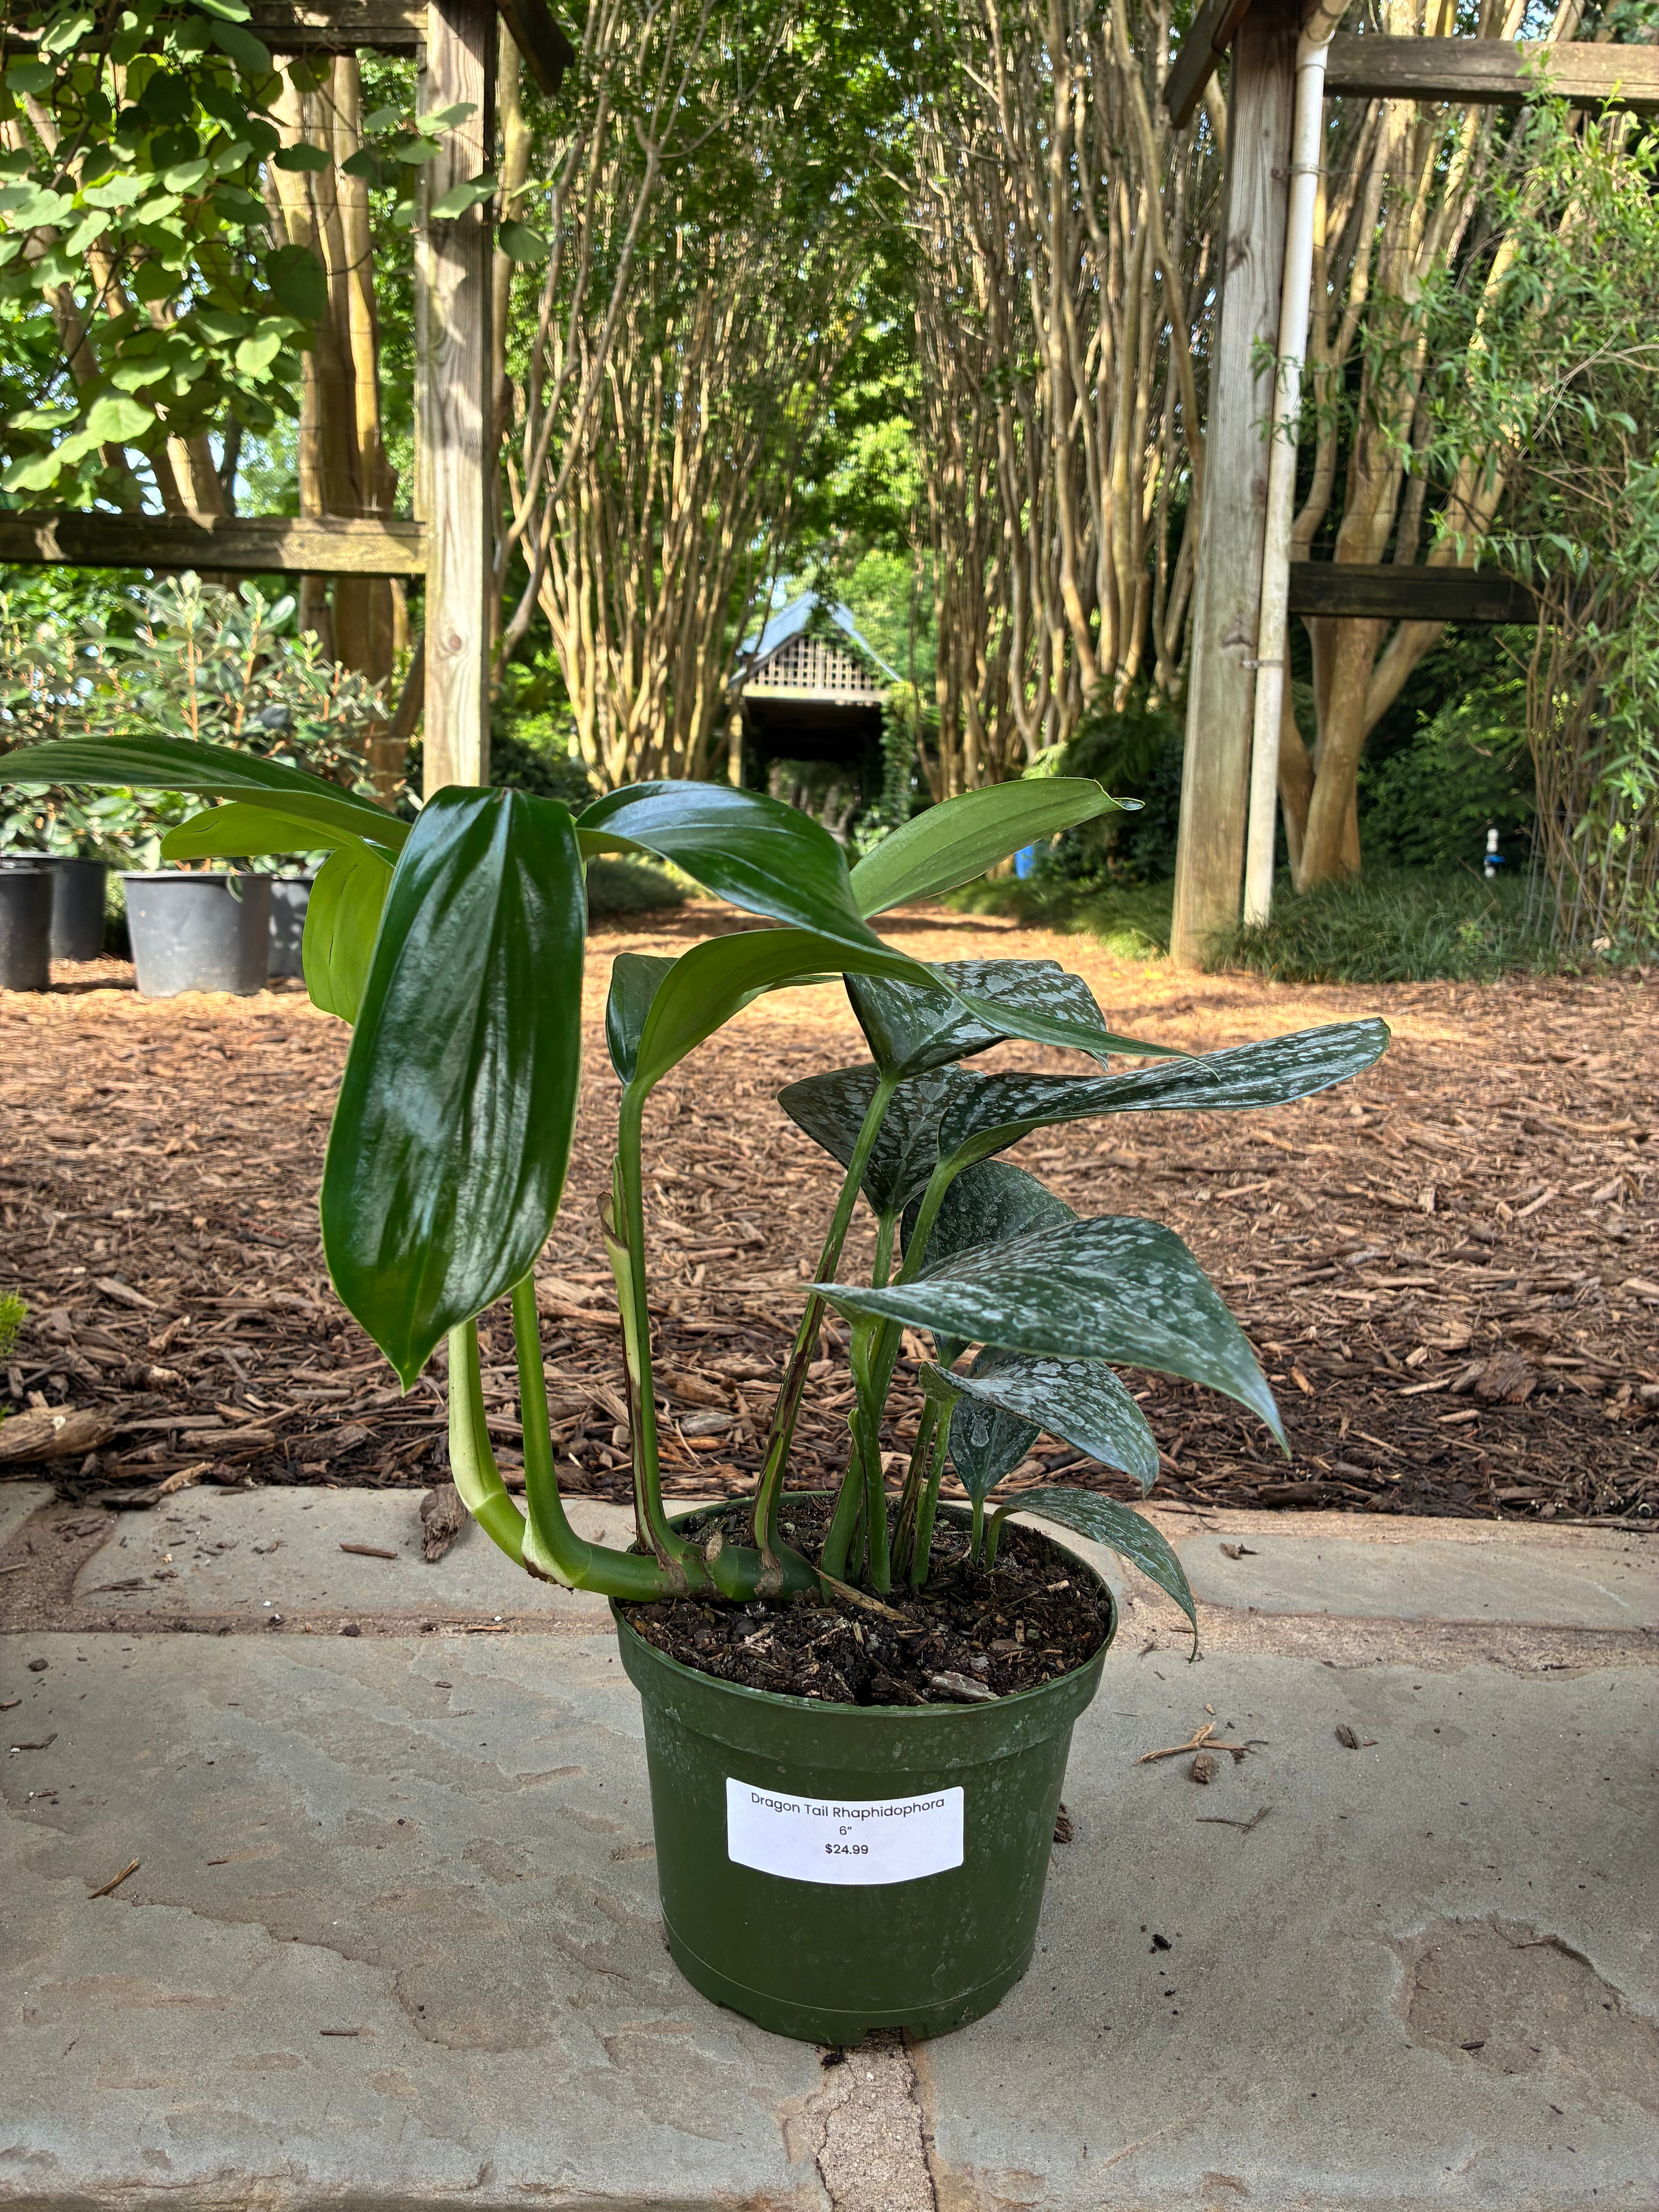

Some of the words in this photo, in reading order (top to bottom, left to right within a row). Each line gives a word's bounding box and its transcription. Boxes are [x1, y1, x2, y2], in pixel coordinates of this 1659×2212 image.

[751, 1792, 800, 1813] Dragon
[804, 1805, 828, 1817] Tail
[833, 1798, 944, 1821] Rhaphidophora
[825, 1843, 868, 1855] $24.99
